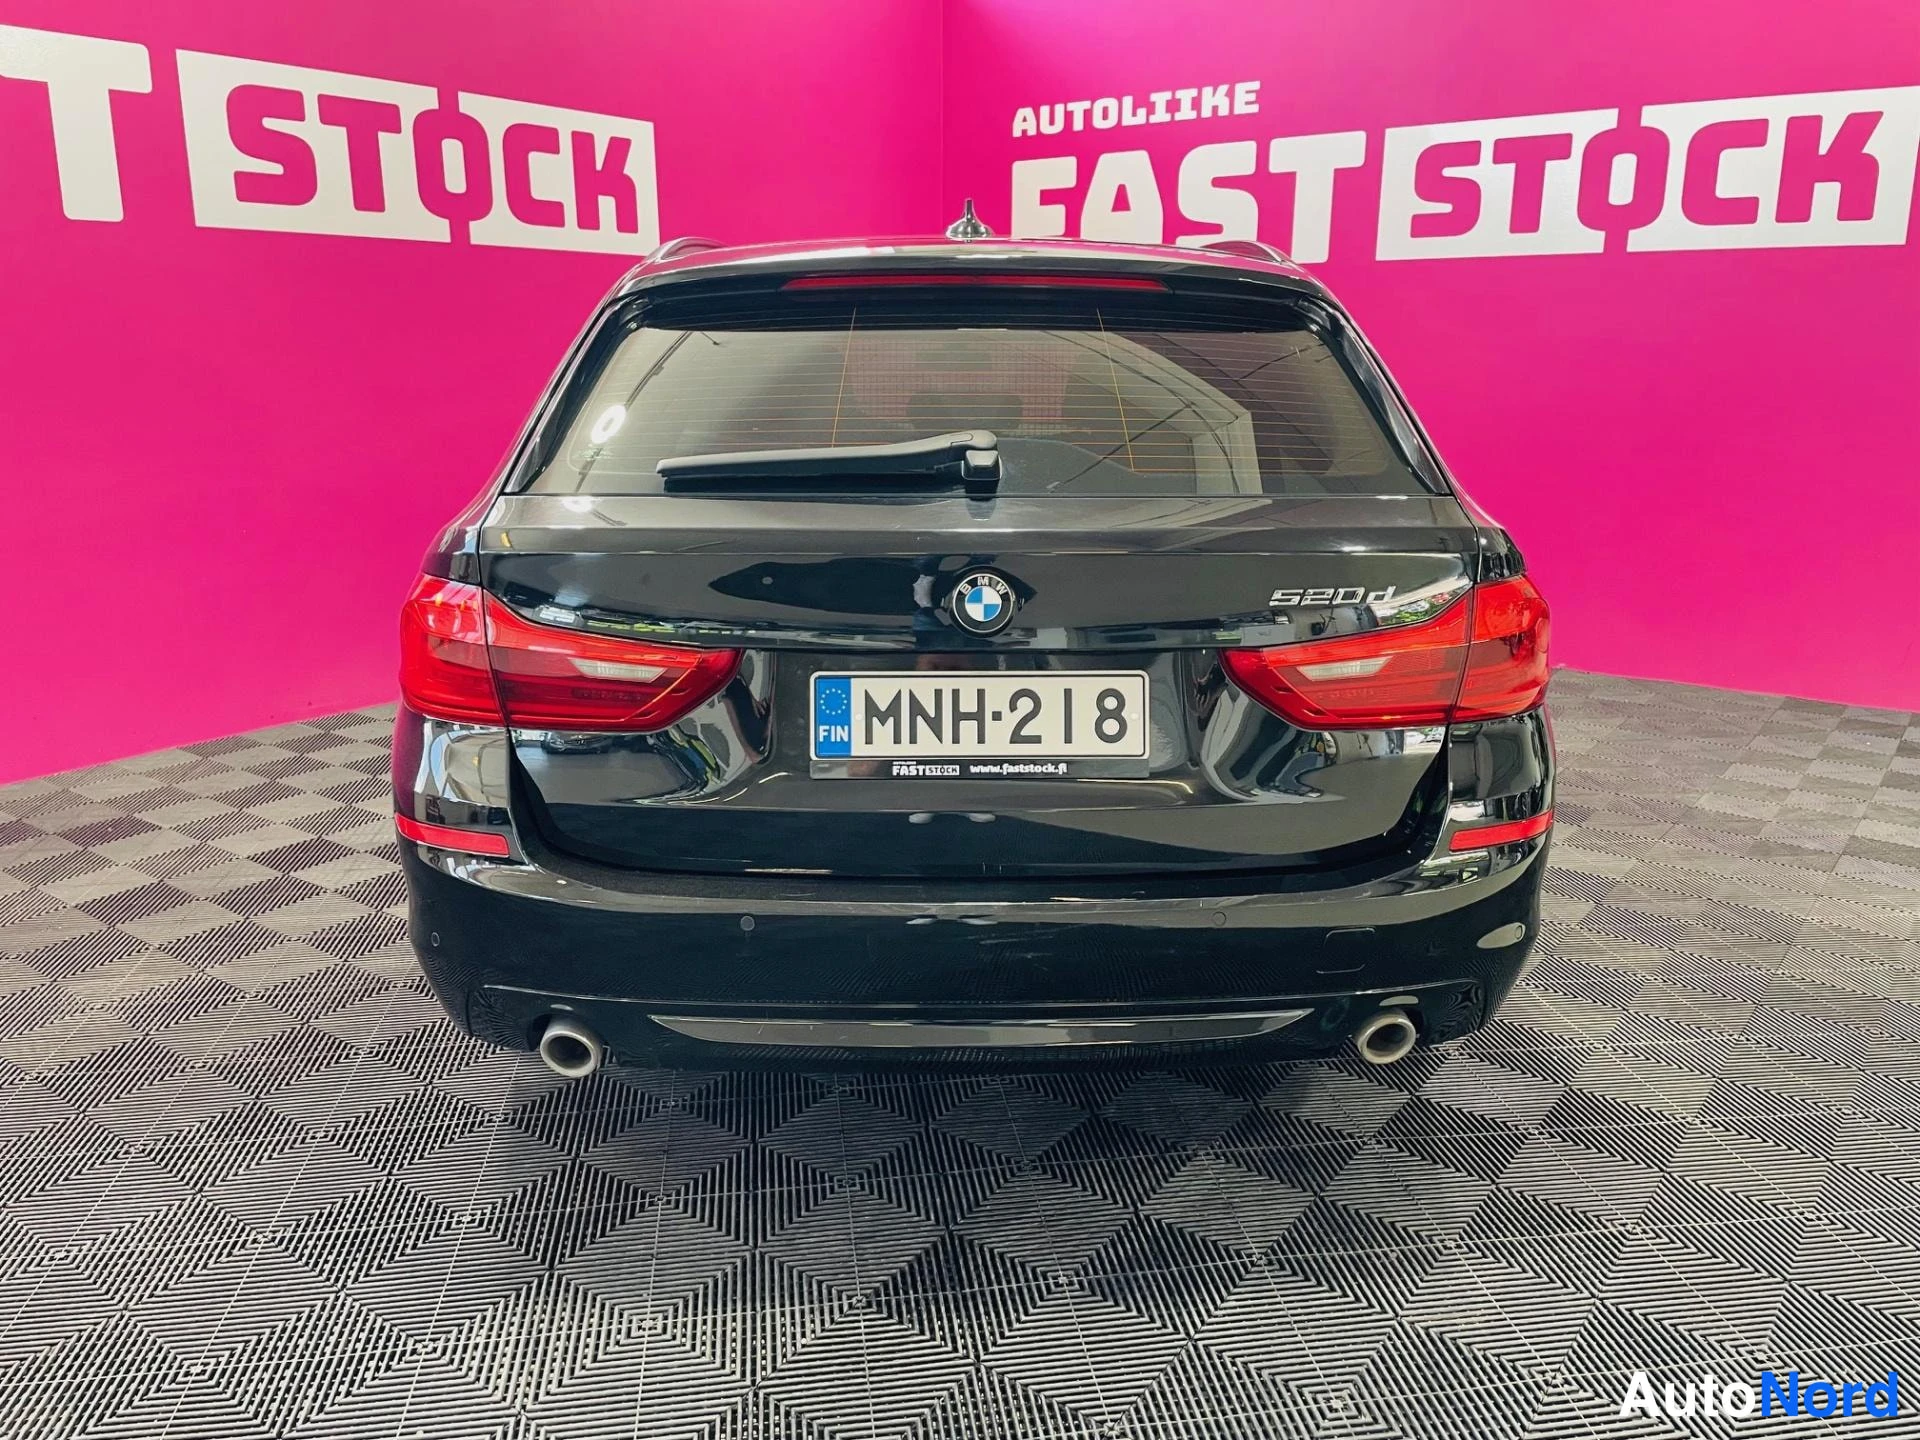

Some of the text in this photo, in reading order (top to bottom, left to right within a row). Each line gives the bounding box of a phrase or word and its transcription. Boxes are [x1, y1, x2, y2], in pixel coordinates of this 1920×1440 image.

[1012, 80, 1261, 138] AUTOLIIKE
[226, 83, 640, 235] STOCK
[1011, 110, 1885, 264] FAST STOCK
[960, 576, 1008, 596] BMW
[1268, 585, 1397, 607] 520d
[819, 725, 849, 742] FIN
[969, 763, 1068, 776] www.faststock.fi
